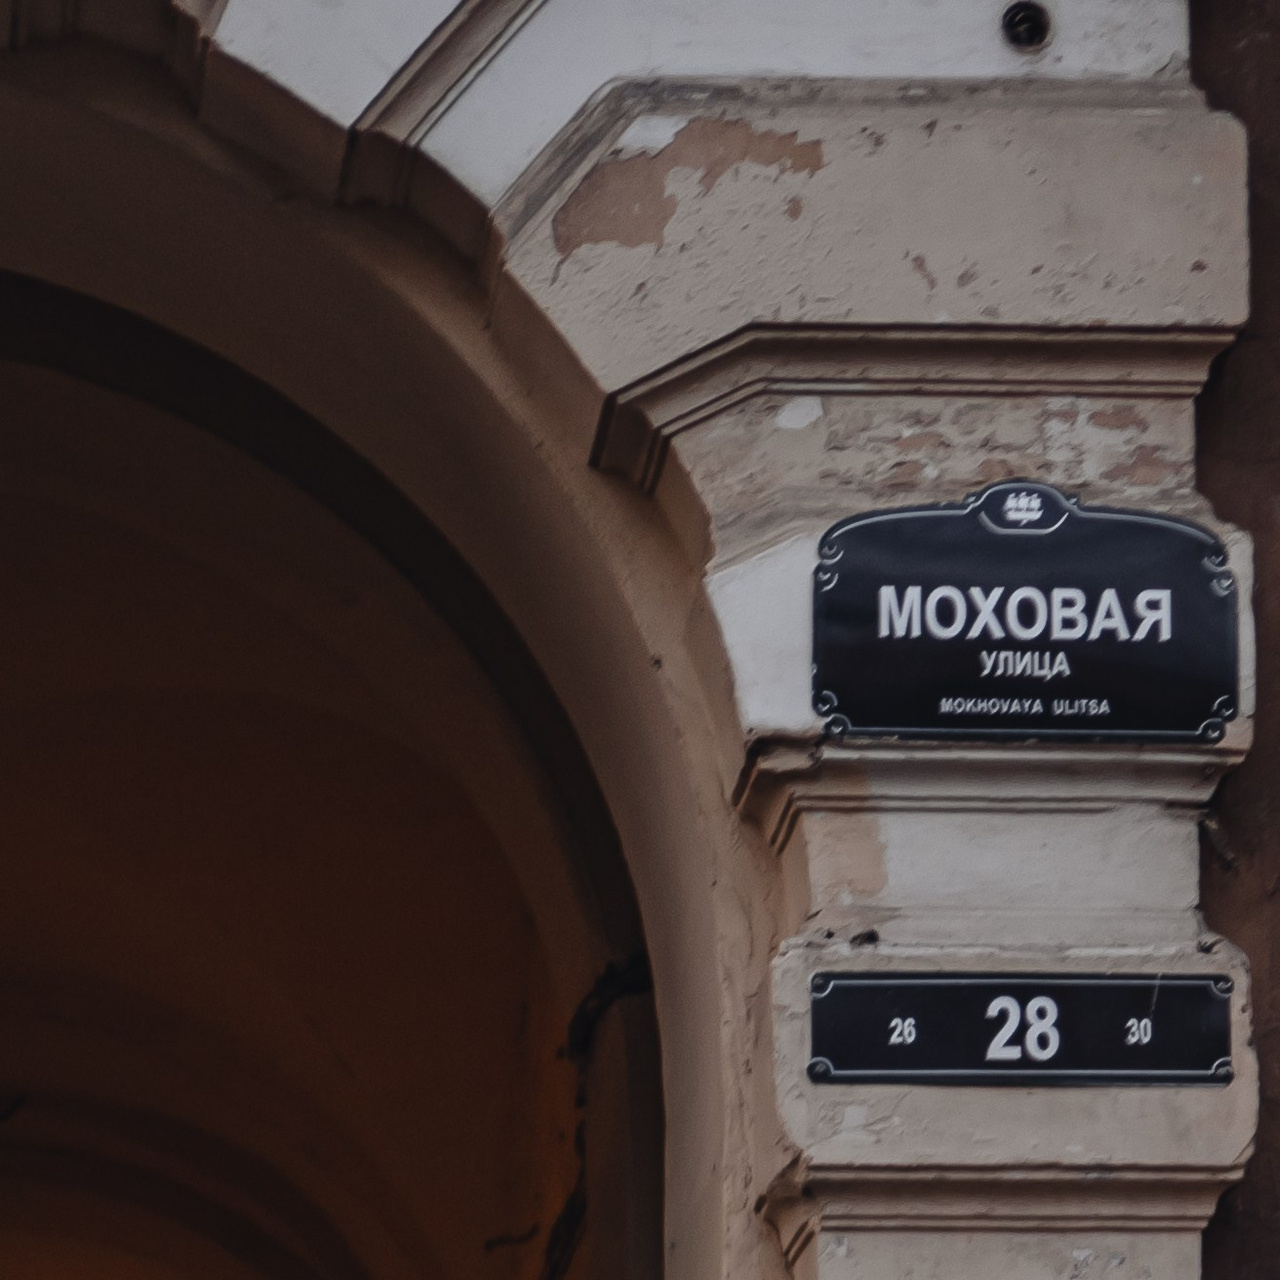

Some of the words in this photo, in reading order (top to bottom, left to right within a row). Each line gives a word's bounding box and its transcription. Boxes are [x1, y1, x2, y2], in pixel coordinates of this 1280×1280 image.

[877, 585, 1172, 642] МОХОВАЯ
[979, 650, 1071, 681] УЛИЦА
[939, 698, 1043, 715] MOKHOVAYA
[1052, 699, 1111, 716] ULITSA
[888, 1017, 916, 1045] 26
[985, 995, 1060, 1061] 28
[1125, 1017, 1152, 1045] 30
